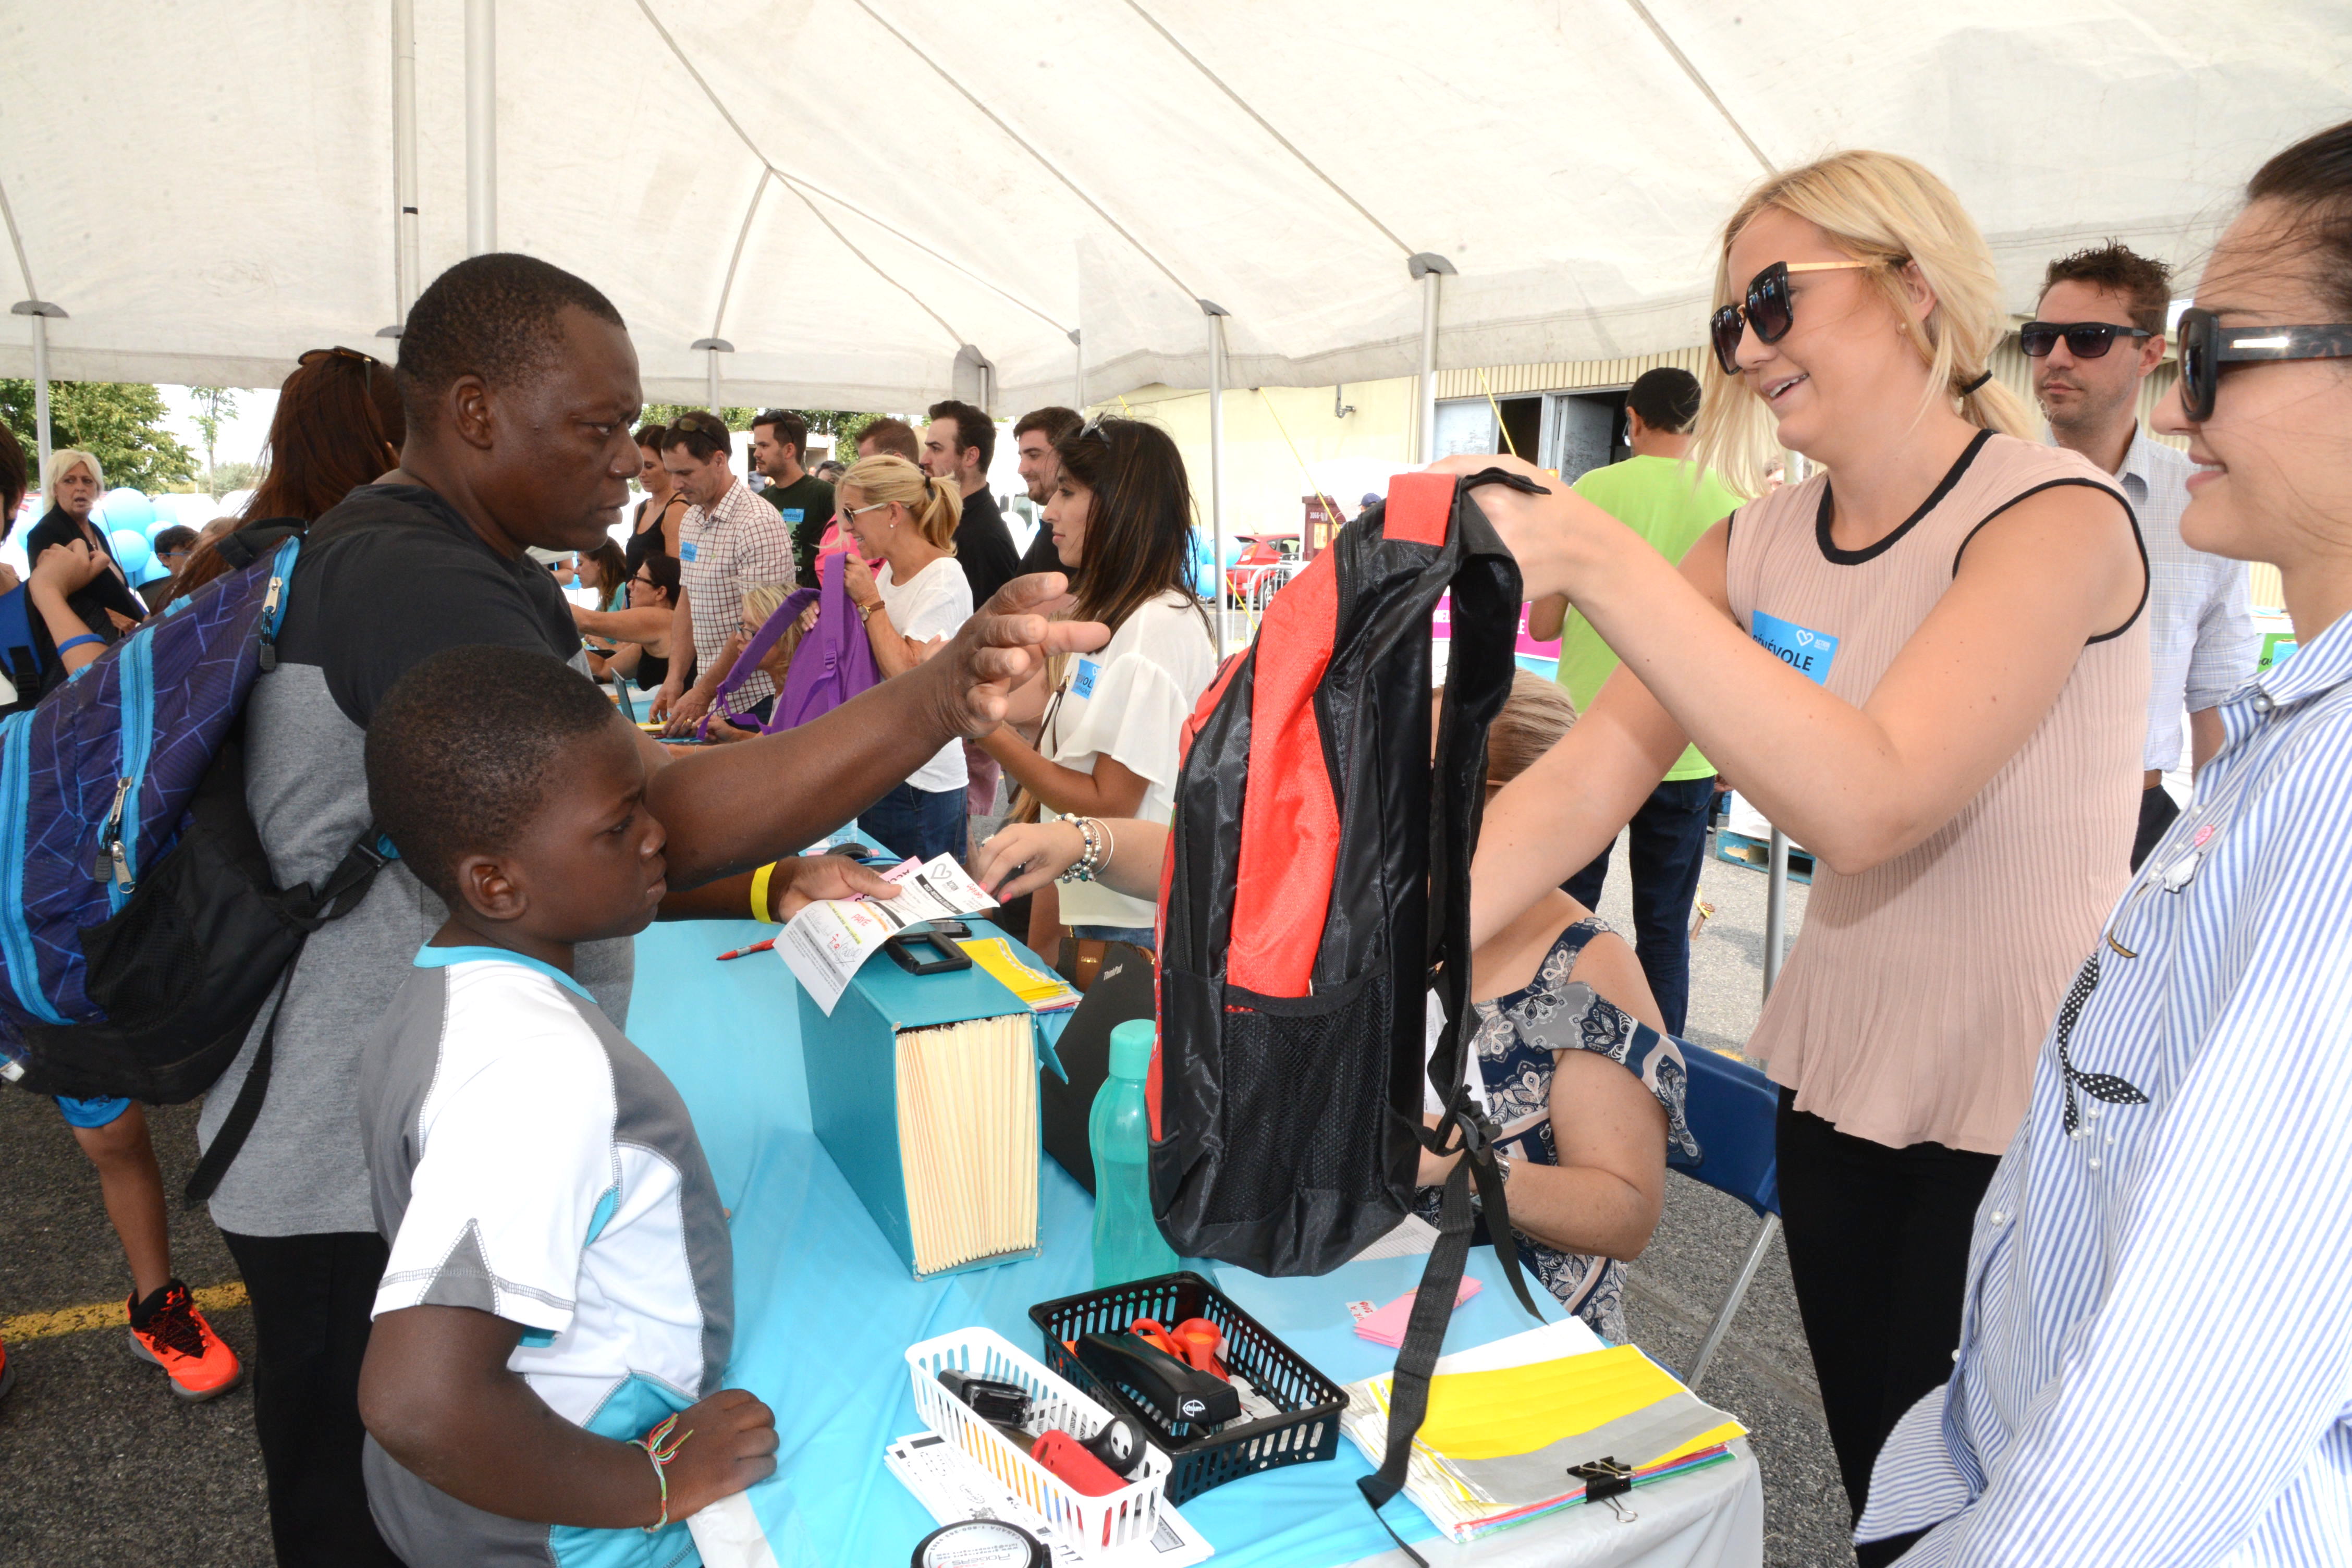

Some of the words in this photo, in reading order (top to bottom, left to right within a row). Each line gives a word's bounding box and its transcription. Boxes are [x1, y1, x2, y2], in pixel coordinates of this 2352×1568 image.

[851, 913, 872, 926] PAYÉ
[990, 1526, 1021, 1539] CANADA
[951, 1552, 1011, 1566] ROGERS
